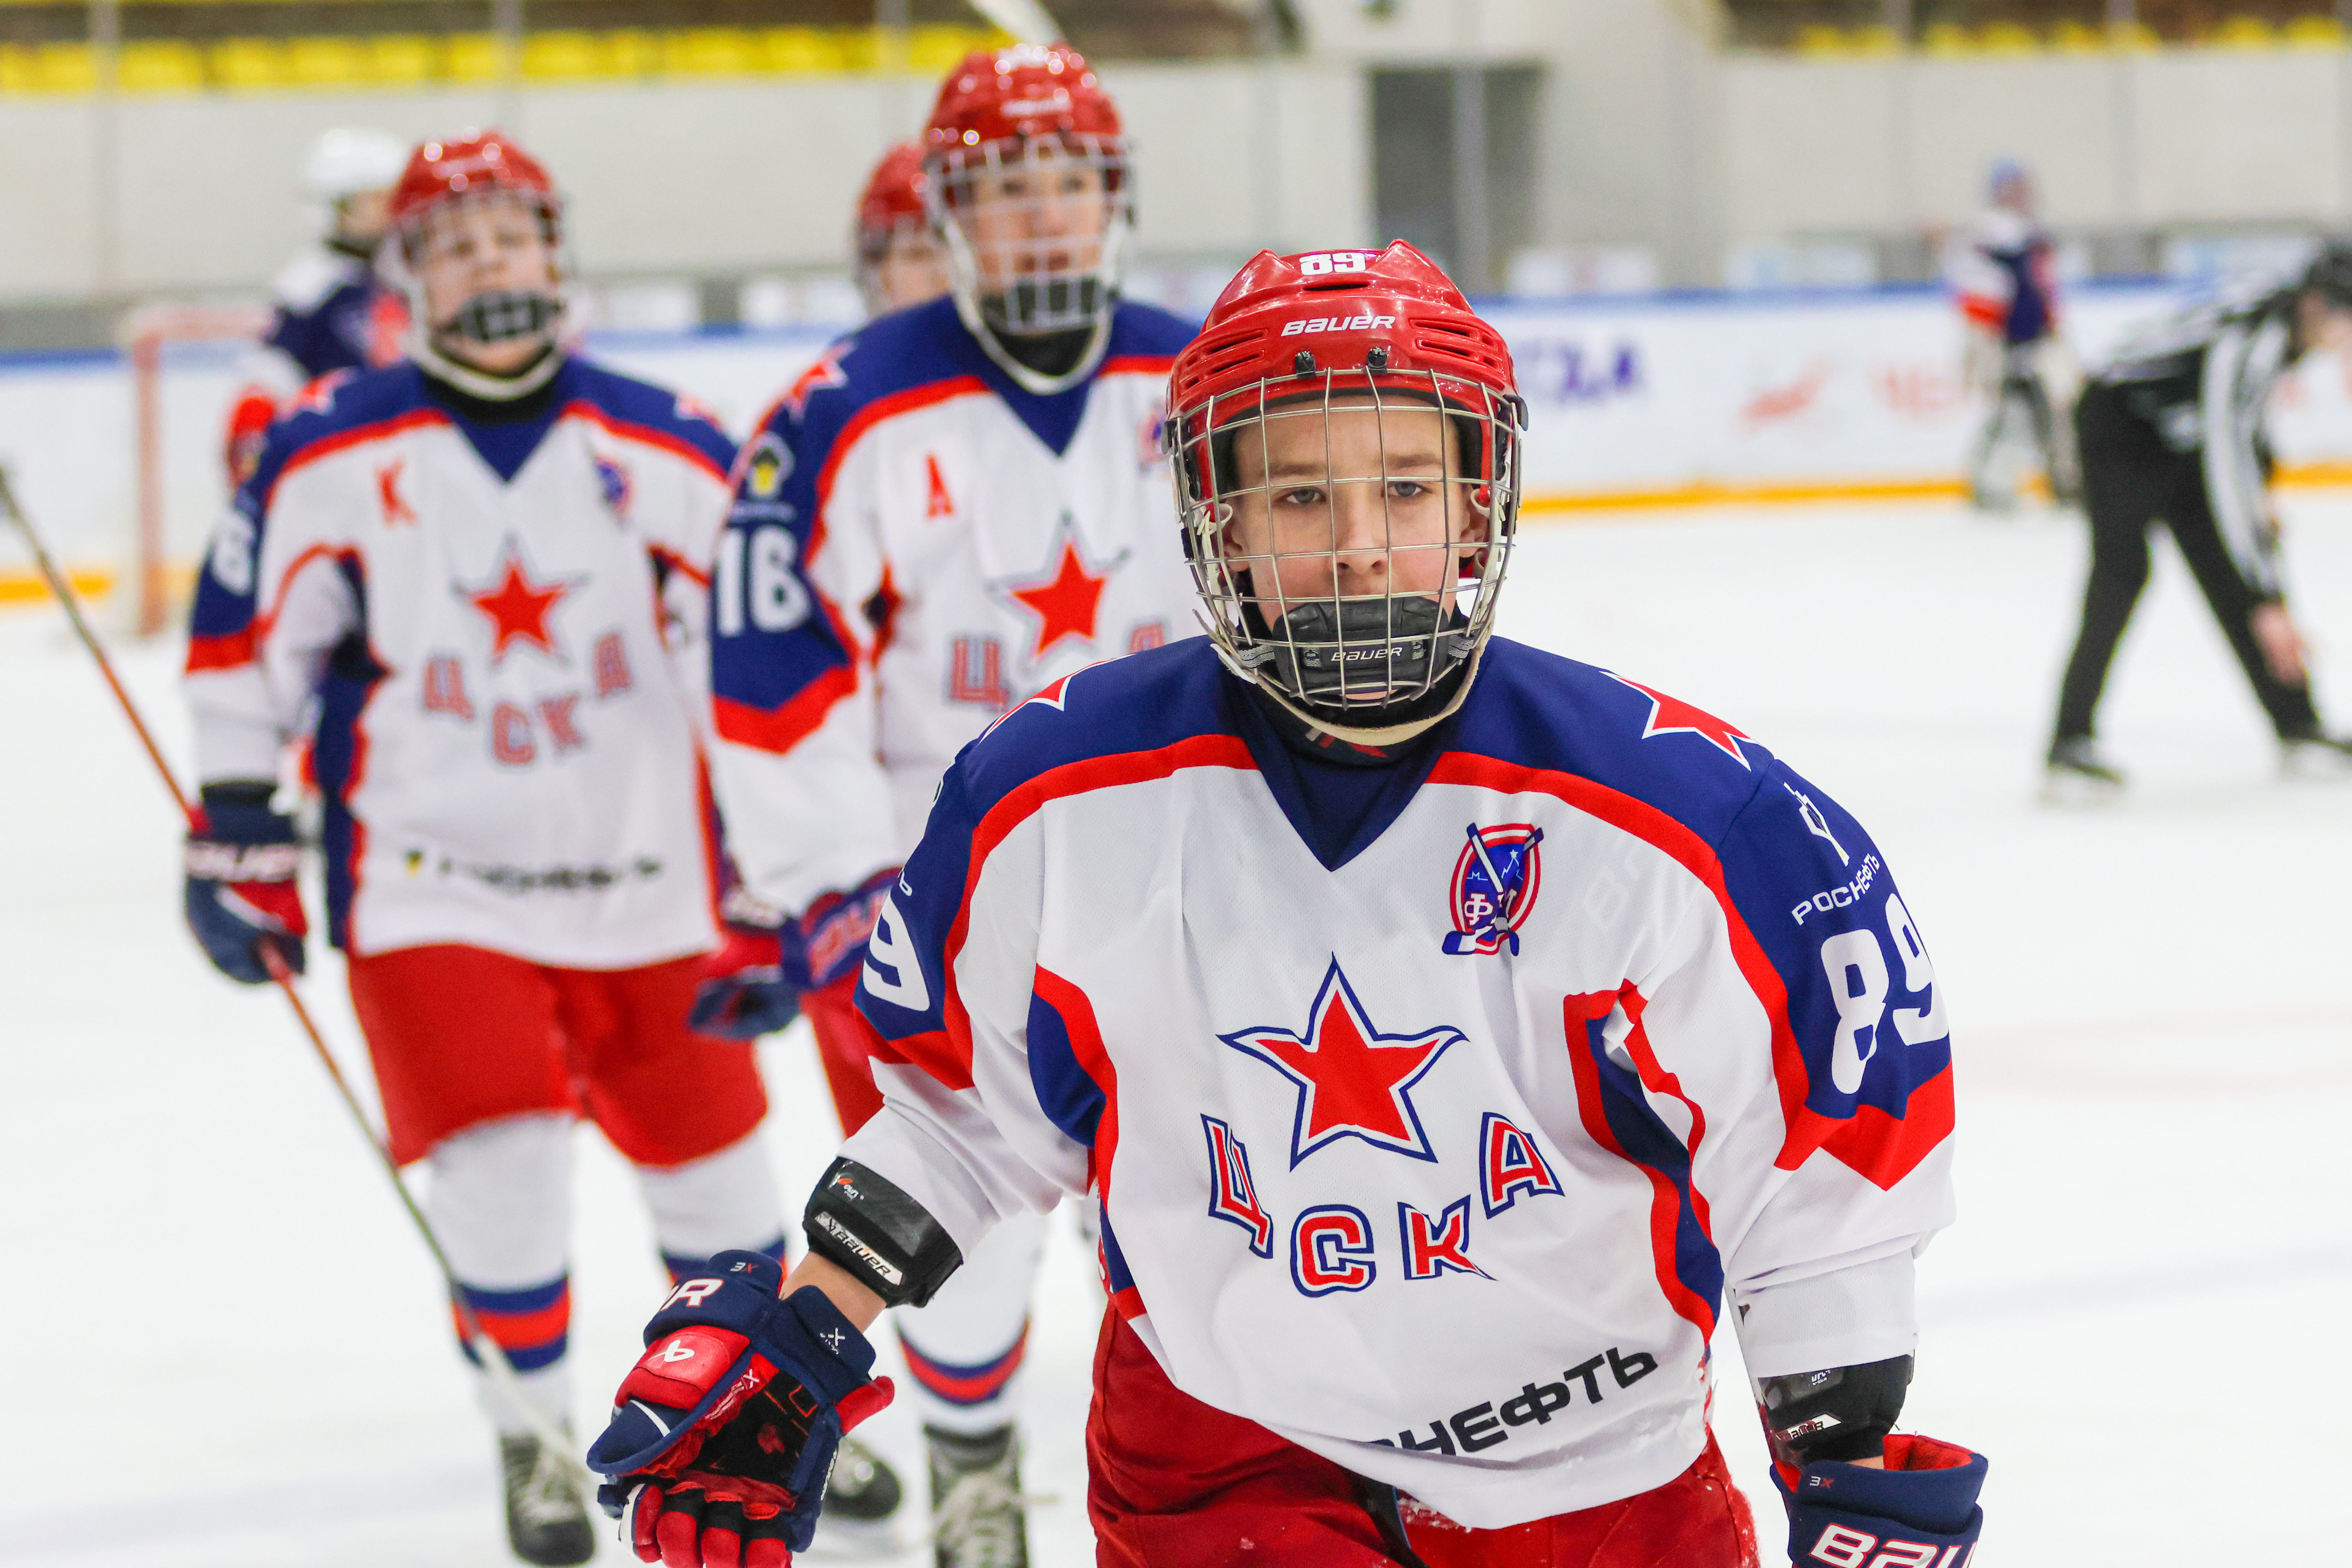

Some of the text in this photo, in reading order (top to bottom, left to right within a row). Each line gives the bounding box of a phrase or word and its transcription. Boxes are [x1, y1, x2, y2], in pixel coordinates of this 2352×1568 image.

[1299, 252, 1366, 276] 89
[1281, 315, 1396, 337] BAUER
[717, 524, 812, 635] 16
[1331, 647, 1403, 661] BAUER
[1792, 853, 1880, 926] РОСНЕФТЬ
[1820, 892, 1949, 1094] 89
[1199, 1111, 1566, 1298] ЦСКА
[1370, 1347, 1659, 1456] НЕФТЬ
